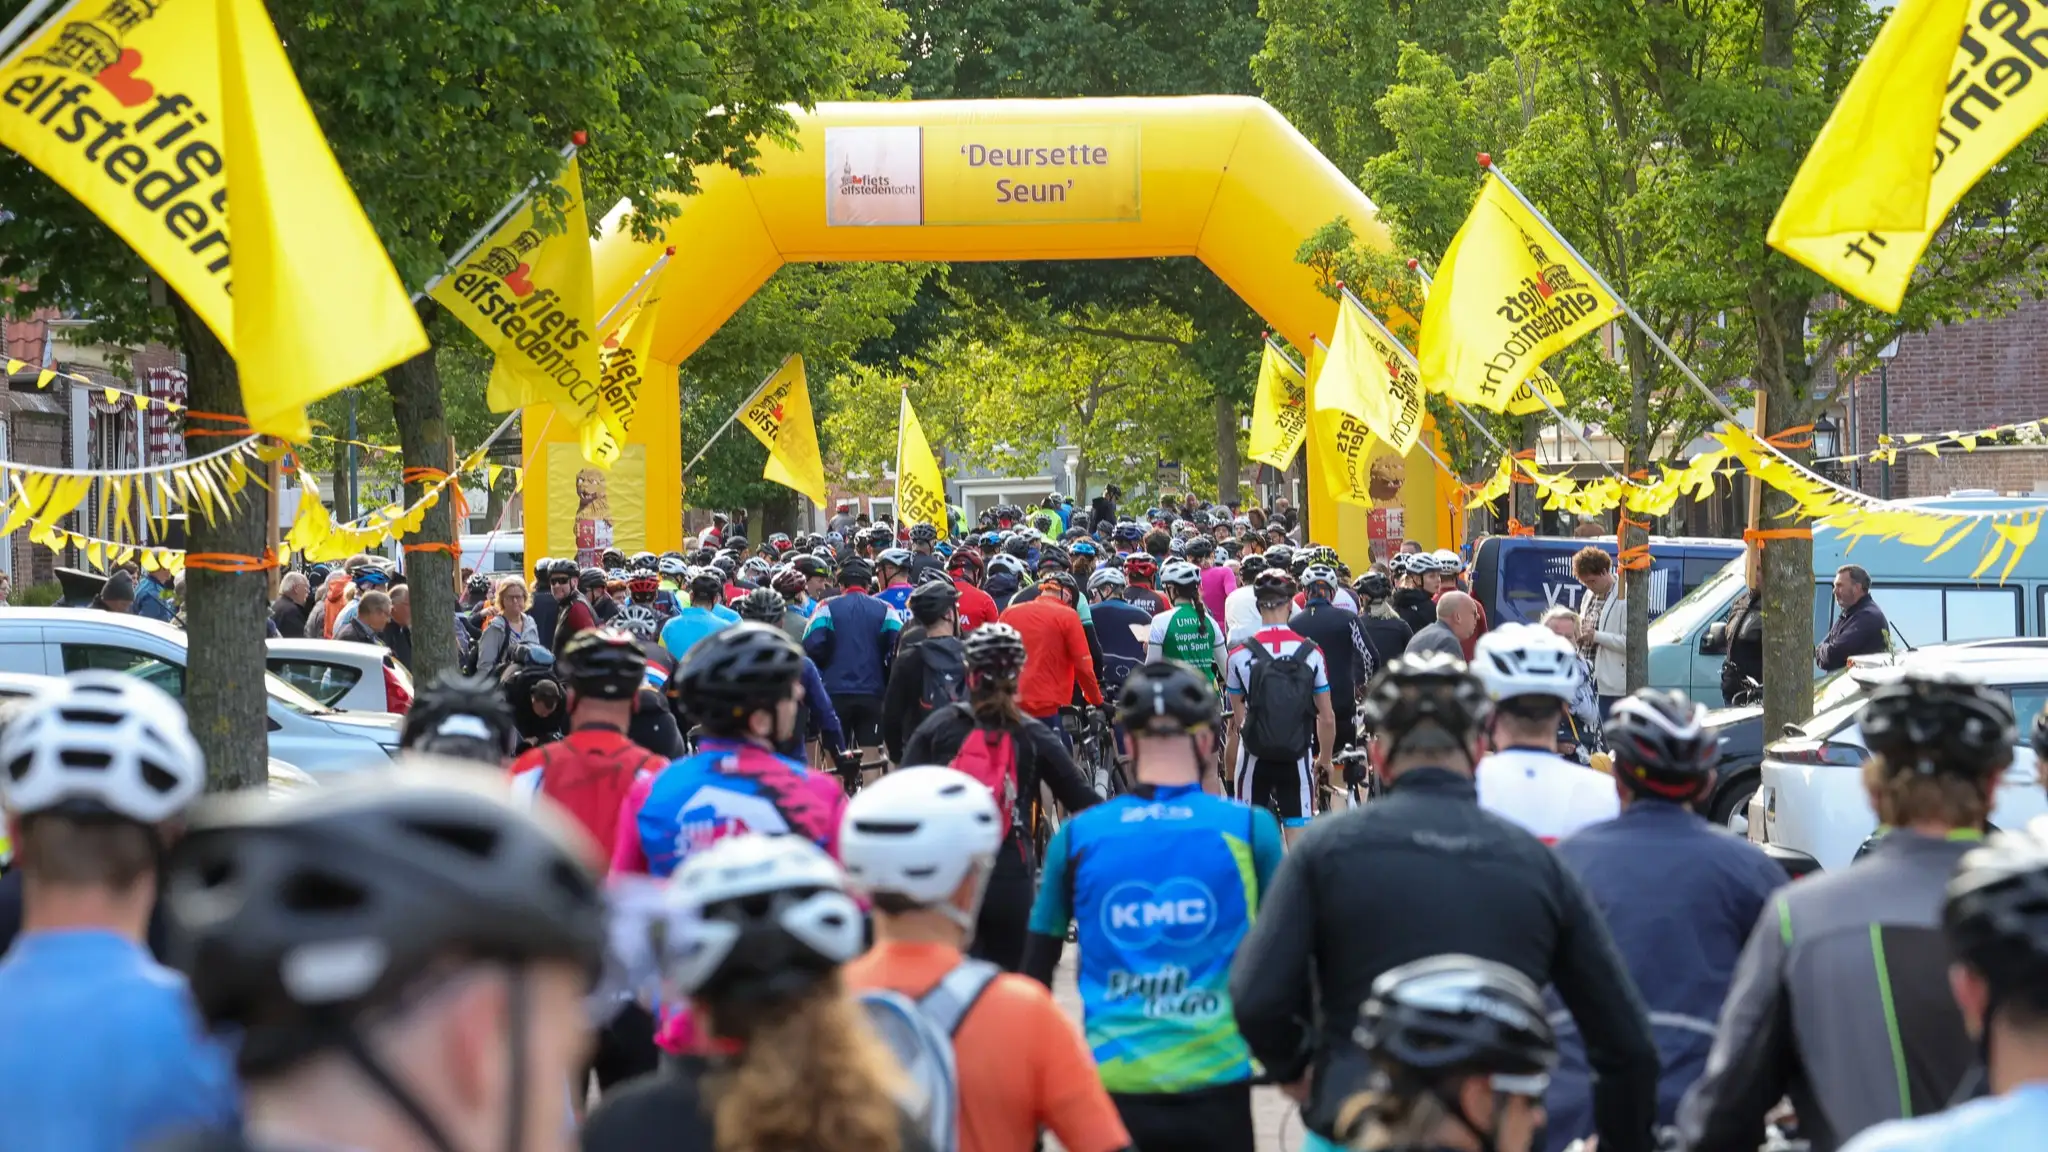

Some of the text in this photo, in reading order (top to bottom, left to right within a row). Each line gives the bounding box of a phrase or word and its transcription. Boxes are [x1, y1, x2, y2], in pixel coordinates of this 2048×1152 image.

[134, 93, 229, 214] fie
[3, 74, 233, 298] elfsteden
[841, 184, 916, 195] elfstedentocht
[862, 174, 890, 186] fiets
[520, 287, 590, 350] fiets
[453, 271, 600, 417] elfstedentoch
[902, 471, 943, 515] fiets
[1176, 617, 1202, 628] UNIV
[1191, 643, 1211, 653] Sport
[1110, 898, 1206, 928] KMC
